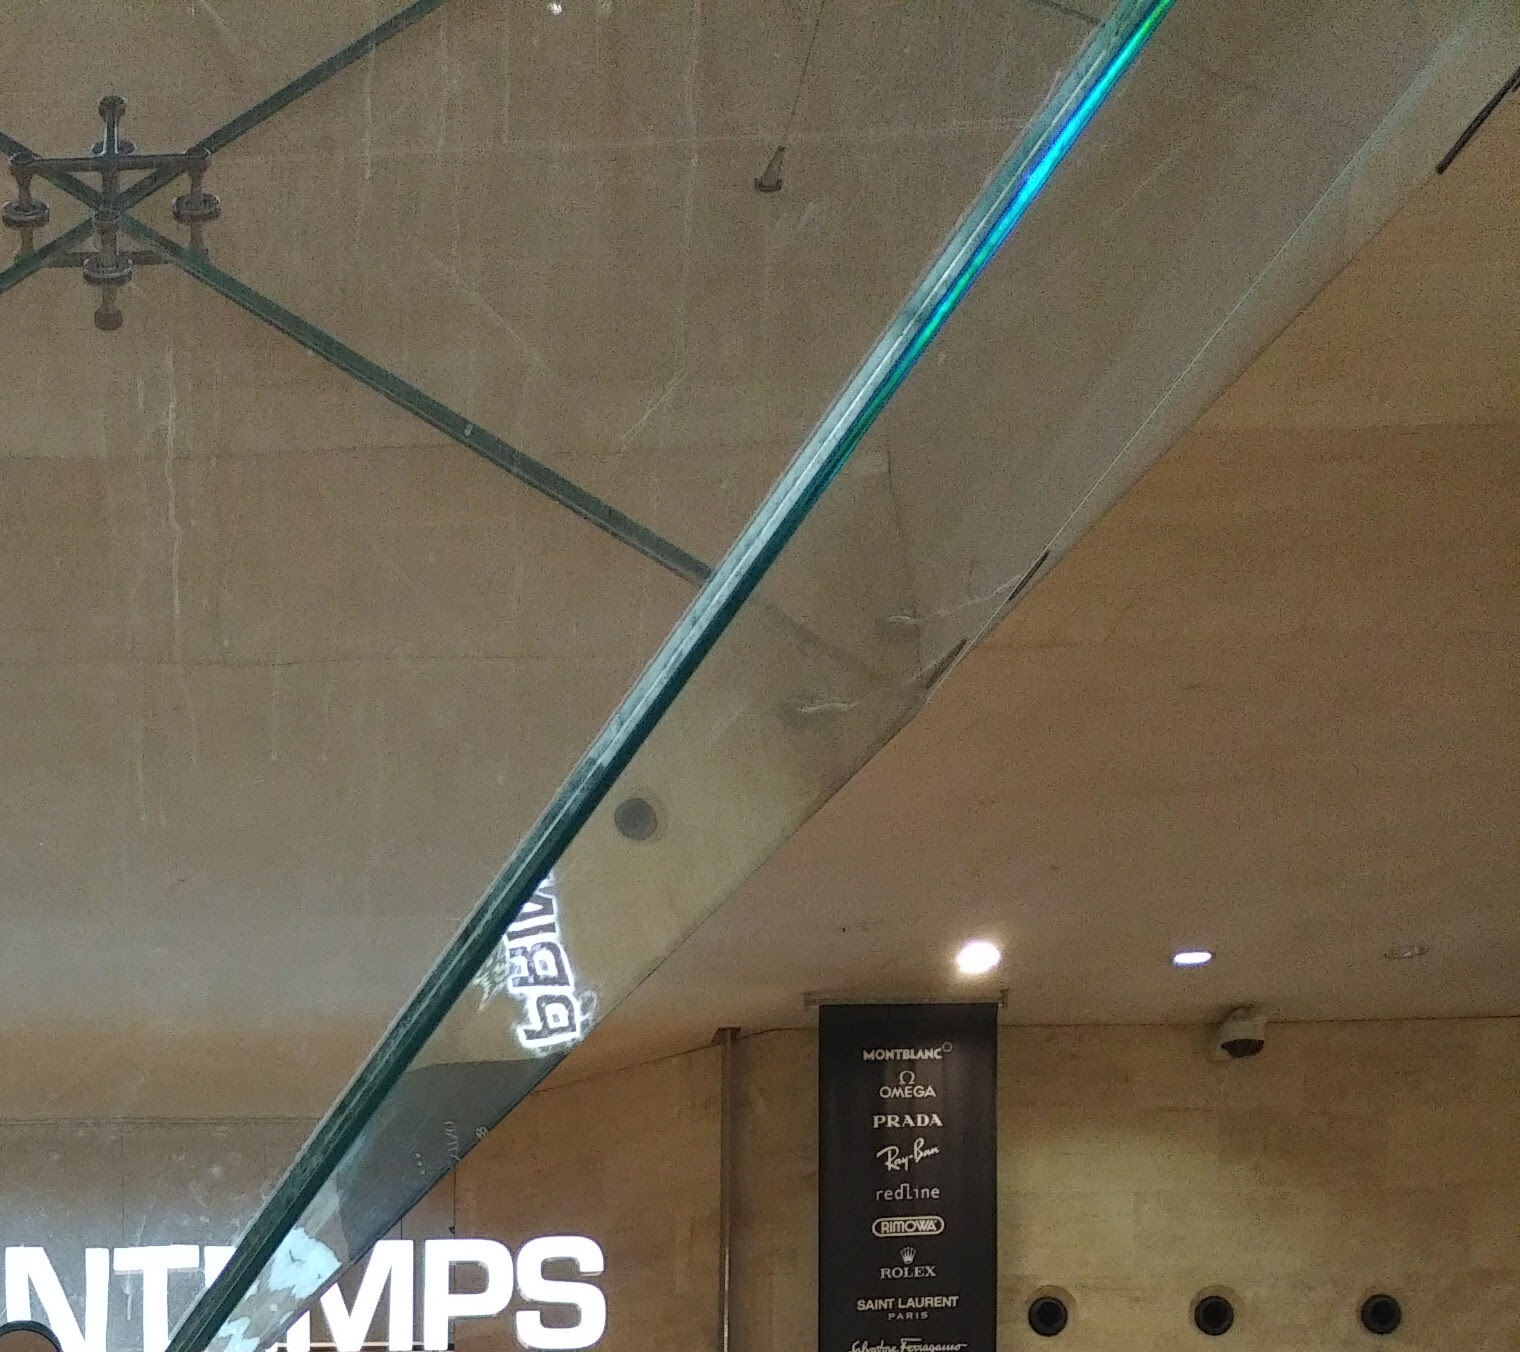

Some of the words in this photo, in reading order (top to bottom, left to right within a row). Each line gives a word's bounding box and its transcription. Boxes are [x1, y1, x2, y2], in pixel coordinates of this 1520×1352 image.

[863, 1047, 943, 1061] MONTBLANC
[879, 1085, 936, 1099] OMEGA
[873, 1114, 943, 1129] PRADA
[876, 1137, 940, 1171] Ray-Ban
[876, 1183, 941, 1201] redline
[880, 1219, 938, 1234] RIMOWA
[879, 1266, 936, 1280] ROLEX
[856, 1298, 895, 1311] SAINT
[898, 1296, 959, 1309] LAURENT
[888, 1311, 929, 1321] PARIS
